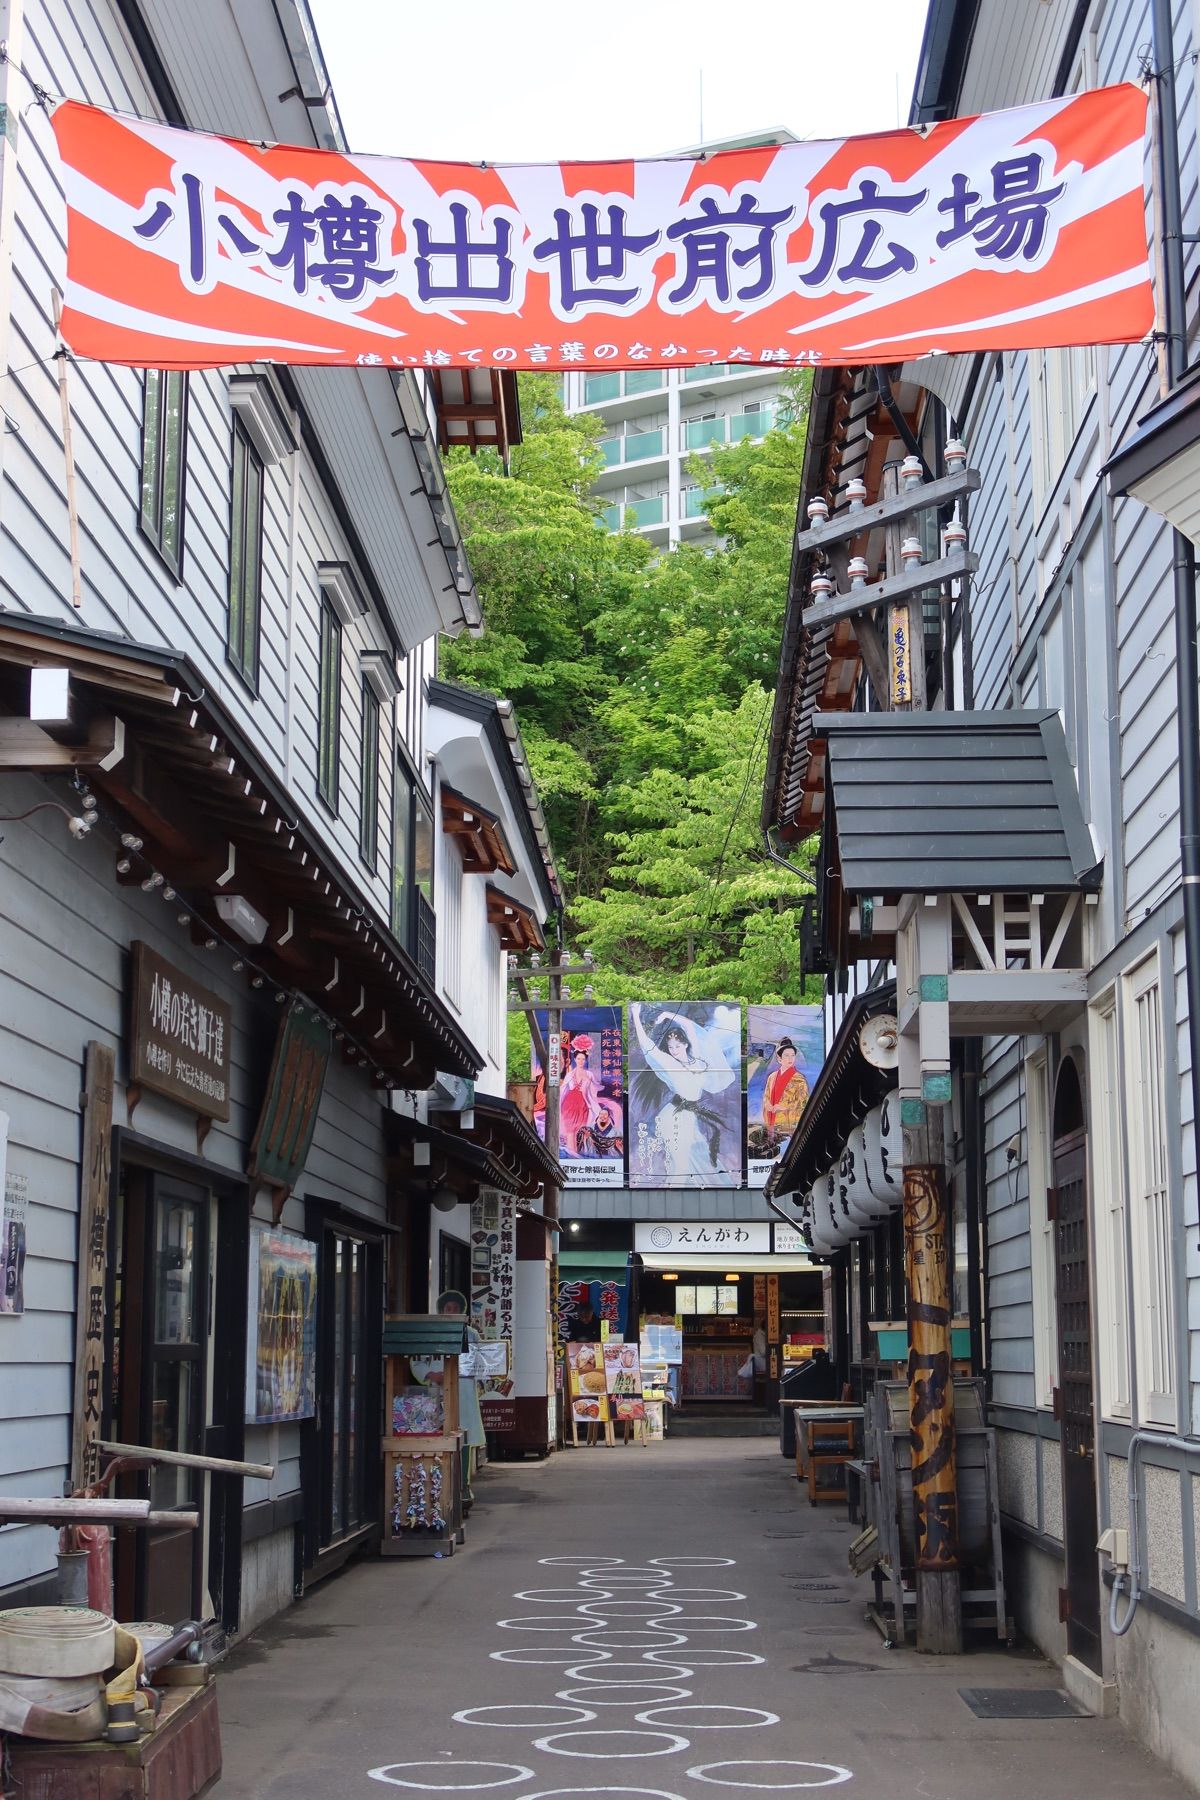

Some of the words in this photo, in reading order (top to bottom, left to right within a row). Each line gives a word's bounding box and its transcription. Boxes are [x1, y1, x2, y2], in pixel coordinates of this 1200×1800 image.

[133, 151, 1069, 308] 小樽出世前広場
[355, 342, 824, 365] 使い捨ての言葉のなかった時代
[150, 972, 224, 1066] 小樽の若き獅子達
[678, 1227, 750, 1243] えんがわ
